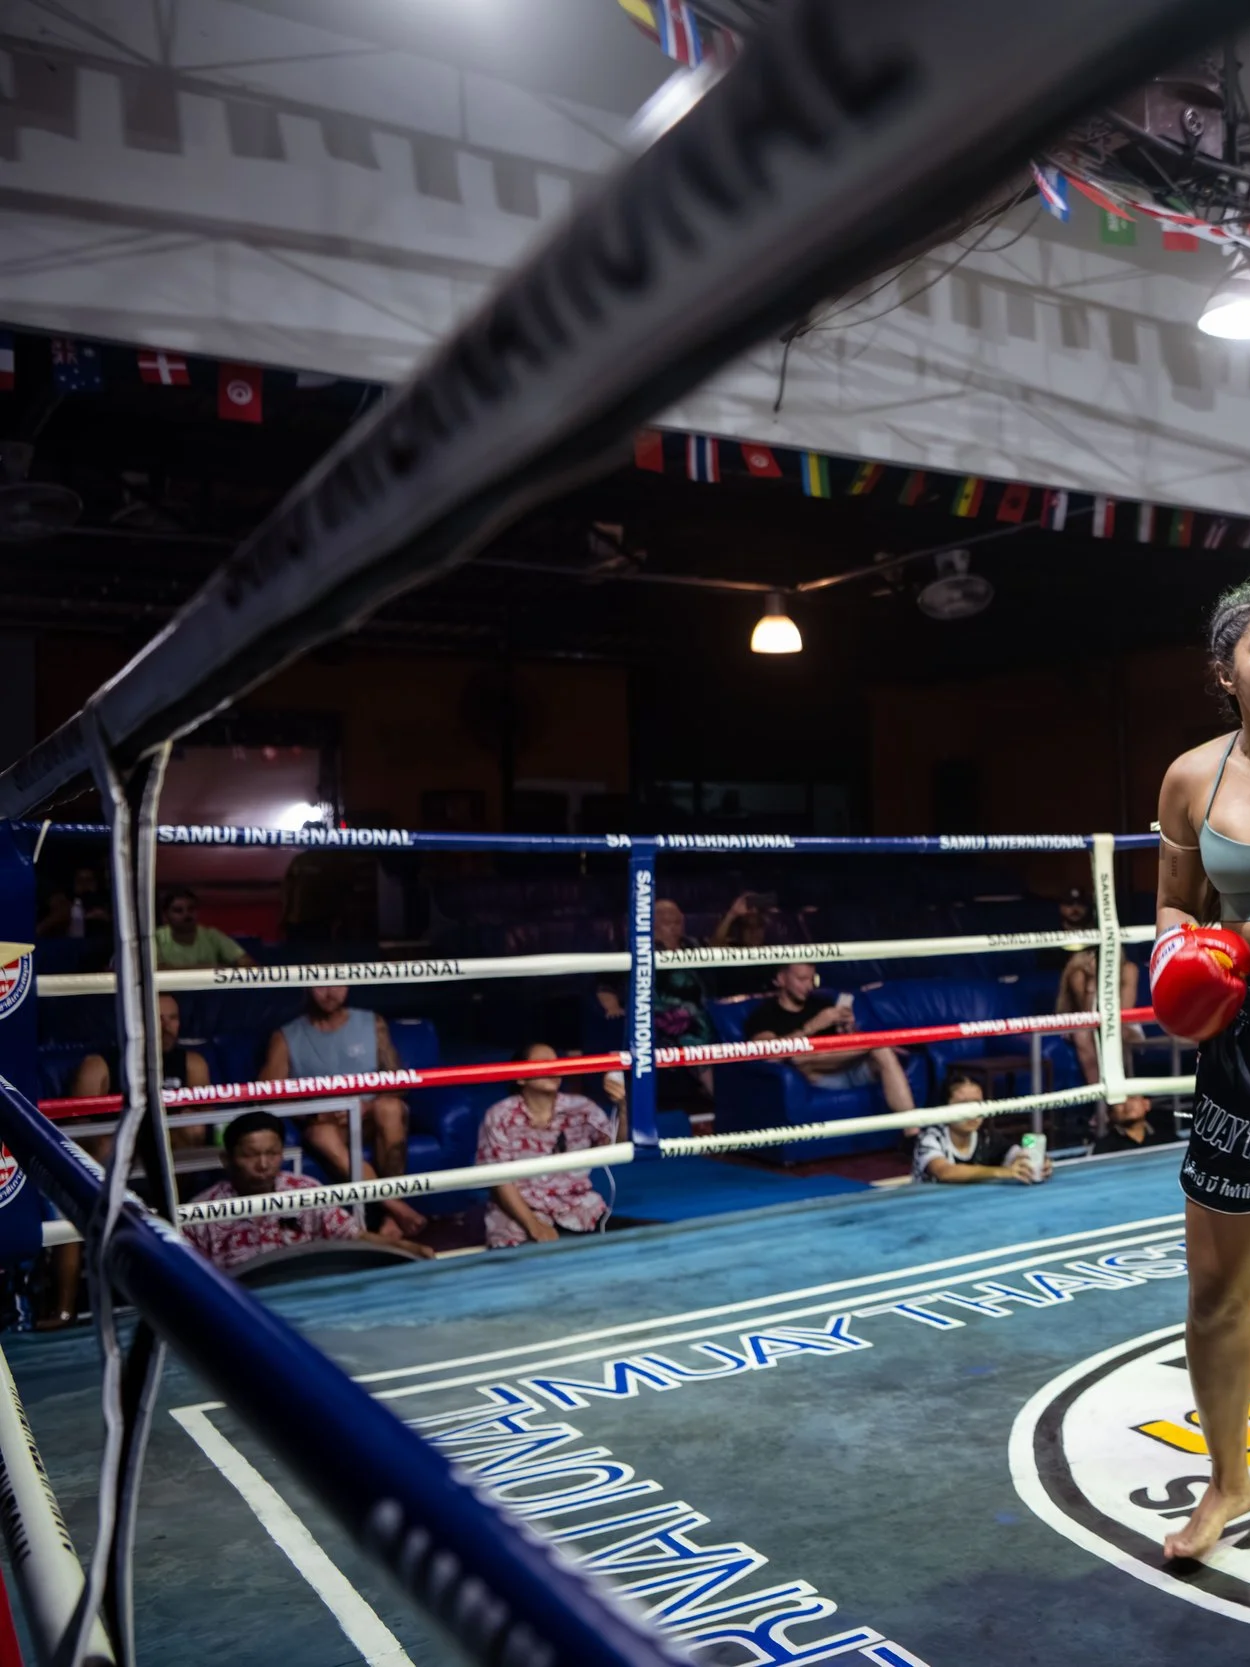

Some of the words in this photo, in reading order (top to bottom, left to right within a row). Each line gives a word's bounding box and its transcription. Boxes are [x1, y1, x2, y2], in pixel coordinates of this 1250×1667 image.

[158, 825, 237, 844] SAMUI
[244, 827, 414, 846] INTERNATIONAL
[668, 834, 795, 848] INTERNATIONAL
[939, 834, 985, 850] SAMUI
[988, 834, 1087, 849] INTERNATIONAL
[635, 870, 652, 932] SAMUI
[1100, 873, 1112, 921] SAMUI
[658, 947, 715, 964] SAMUI
[720, 943, 844, 961] INTERNATIONAL
[213, 966, 290, 985] SAMUI
[299, 959, 465, 982] INTERNATIONAL
[1103, 925, 1117, 1039] INTERNATIONAL
[635, 935, 652, 1078] INTERNATIONAL
[959, 1019, 1007, 1036] SAMUI
[1007, 1011, 1101, 1032] INTERNATIONA
[684, 1037, 814, 1062] INTERNATIONAL
[162, 1083, 242, 1103] SAMUI
[249, 1069, 423, 1096] INTERNATIONAL
[176, 1200, 251, 1224] SAMUI
[262, 1177, 436, 1213] INTERNATIONAL
[517, 1312, 873, 1411] MUAY
[853, 1260, 1149, 1331] THAI
